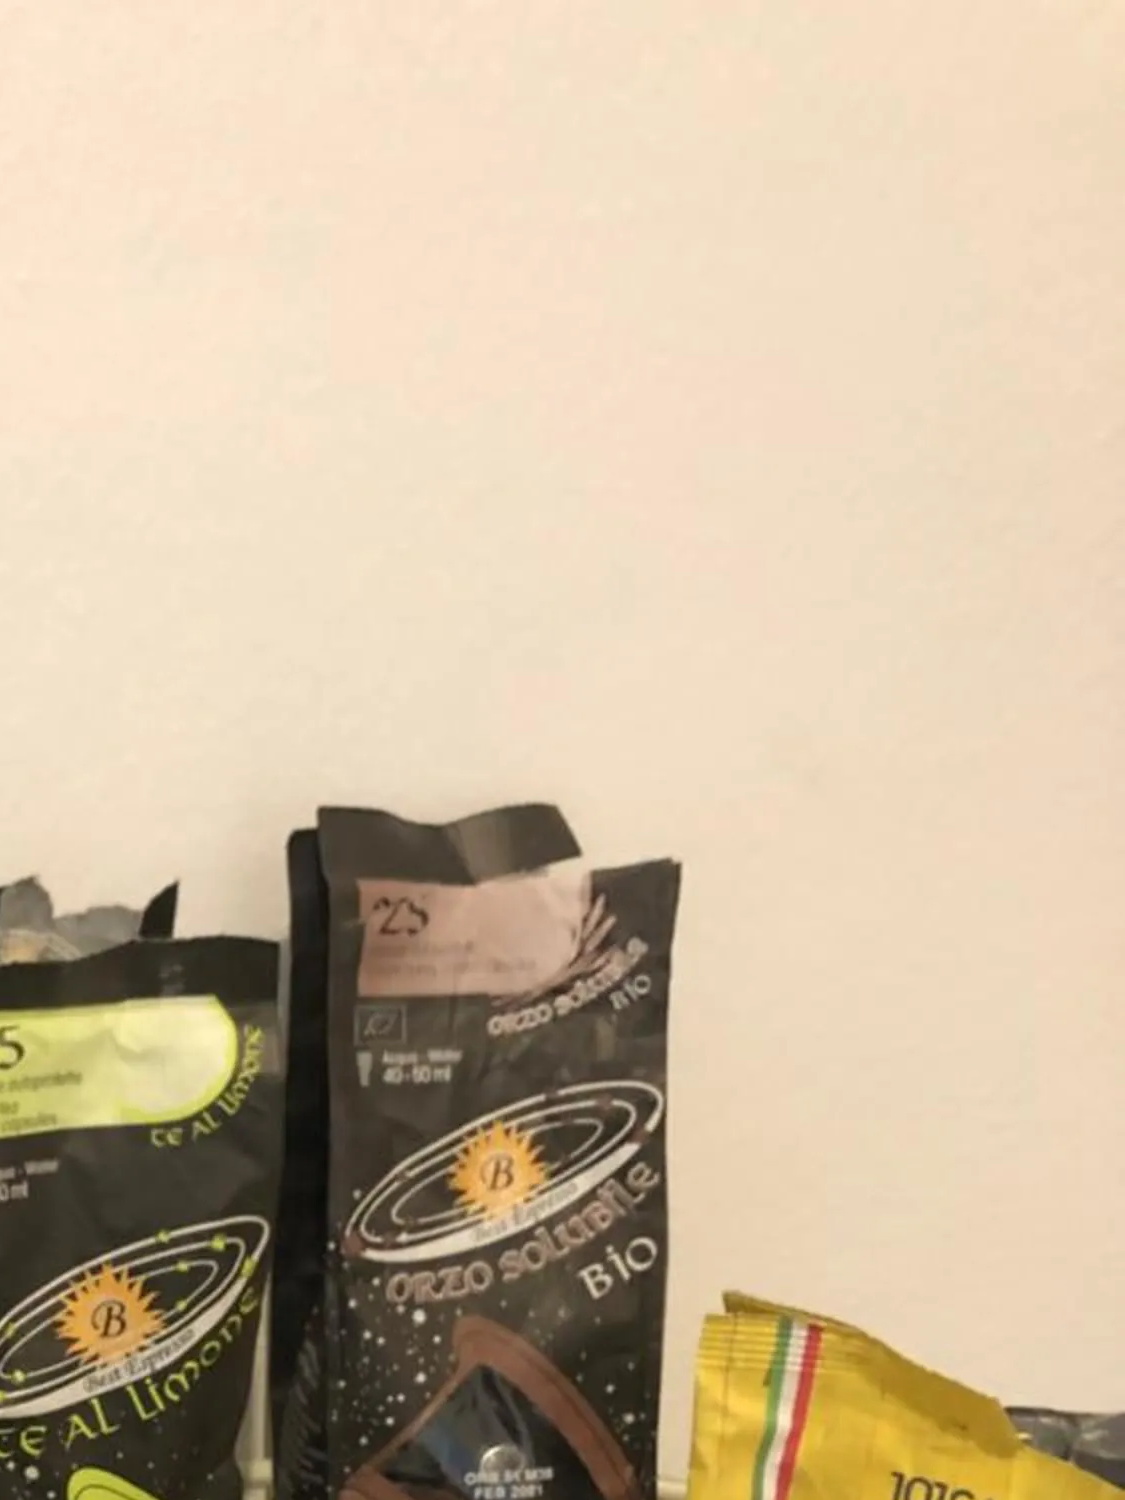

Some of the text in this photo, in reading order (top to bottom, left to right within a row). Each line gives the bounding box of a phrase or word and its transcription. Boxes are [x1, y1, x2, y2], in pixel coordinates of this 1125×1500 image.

[372, 897, 429, 937] 25
[480, 1153, 514, 1192] B
[385, 1260, 494, 1304] ORZO
[578, 1235, 658, 1301] BIO
[91, 1300, 128, 1338] B
[62, 1396, 120, 1451] AL
[126, 1286, 259, 1422] LIMONE
